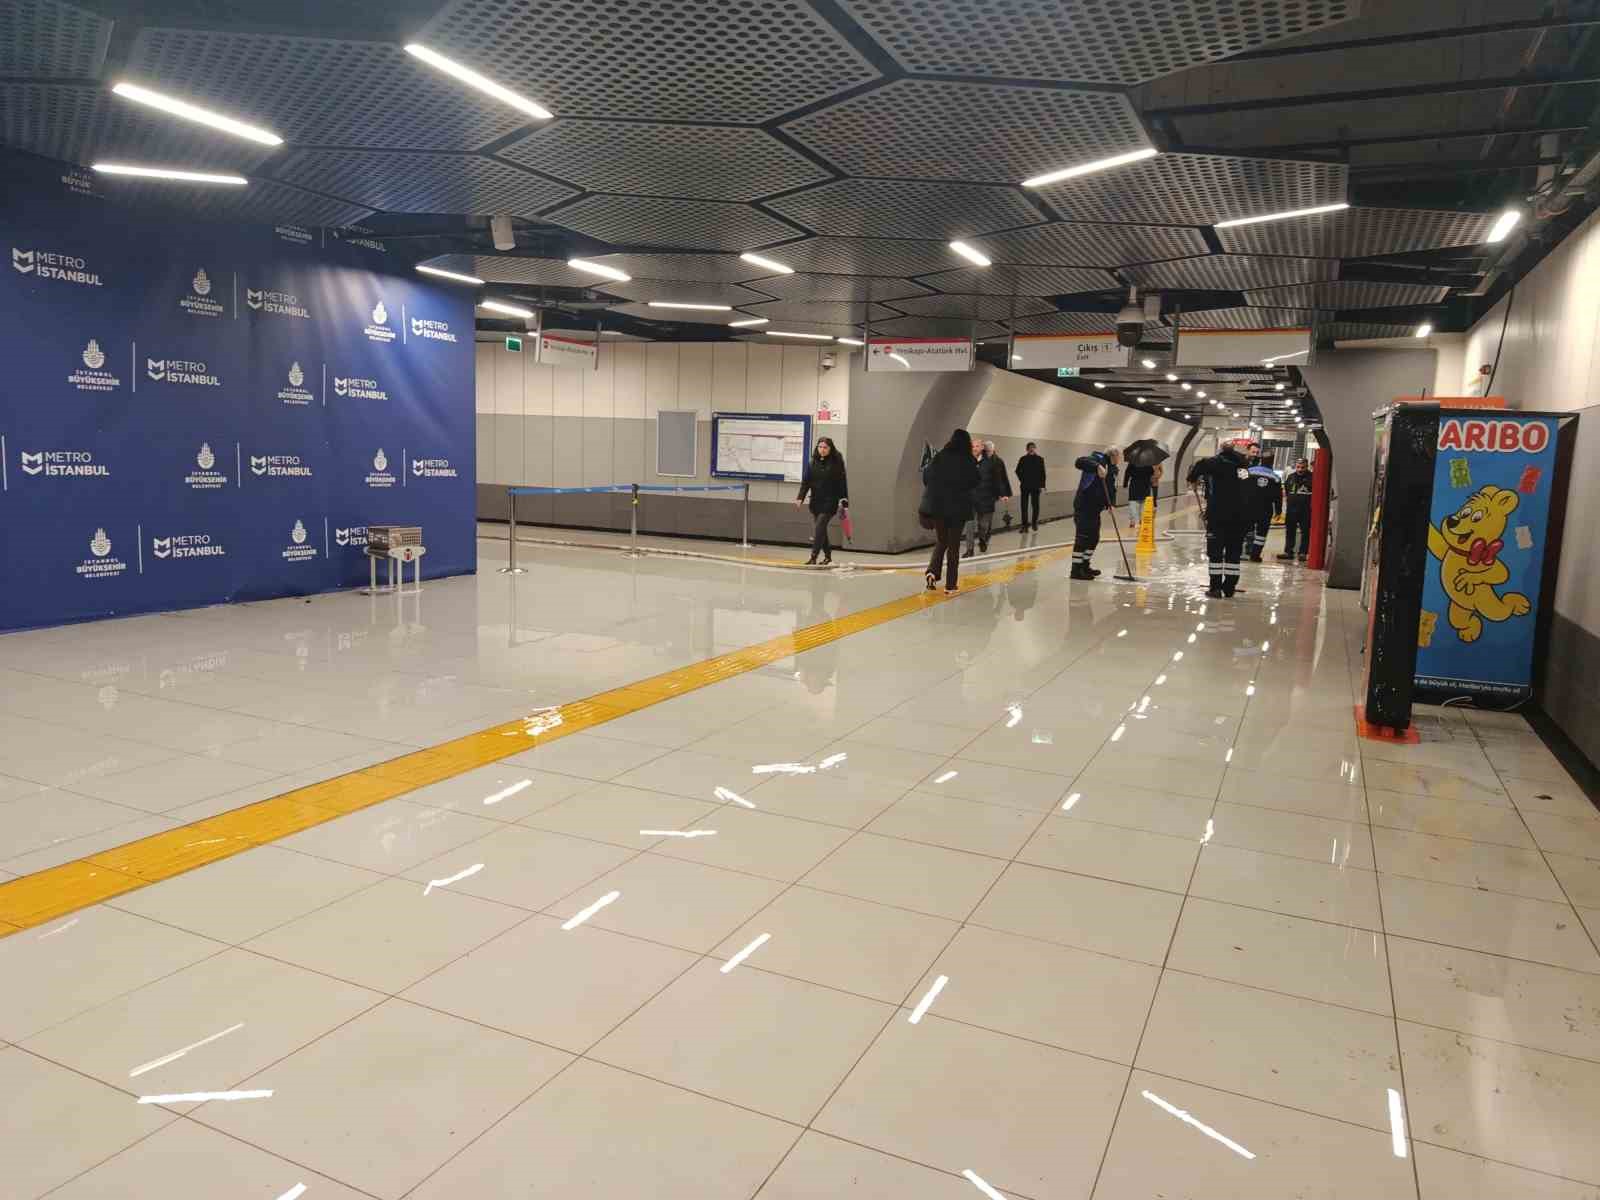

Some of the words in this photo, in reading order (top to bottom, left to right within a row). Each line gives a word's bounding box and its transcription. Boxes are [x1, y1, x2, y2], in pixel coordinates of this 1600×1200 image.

[36, 252, 86, 270] METRO
[36, 265, 103, 286] İSTANBUL
[263, 289, 297, 304] METRO
[263, 301, 311, 318] İSTANBUL
[423, 318, 449, 331] METRO
[423, 327, 457, 342] İSTANBUL
[166, 359, 206, 373] METRO
[167, 370, 221, 386] İSTANBUL
[348, 378, 377, 389] METRO
[348, 386, 388, 400] İSTANBUL
[1438, 421, 1547, 451] ARIBO
[45, 450, 92, 464] METRO
[267, 455, 300, 465] METRO
[45, 463, 110, 476] İSTANBUL
[267, 465, 312, 476] İSTANBUL
[424, 459, 449, 469] METRO
[424, 467, 457, 477] İSTANBUL
[350, 526, 369, 537] MET
[172, 534, 211, 546] METRO
[350, 536, 368, 546] İSTA
[172, 545, 225, 558] İSTANBUL
